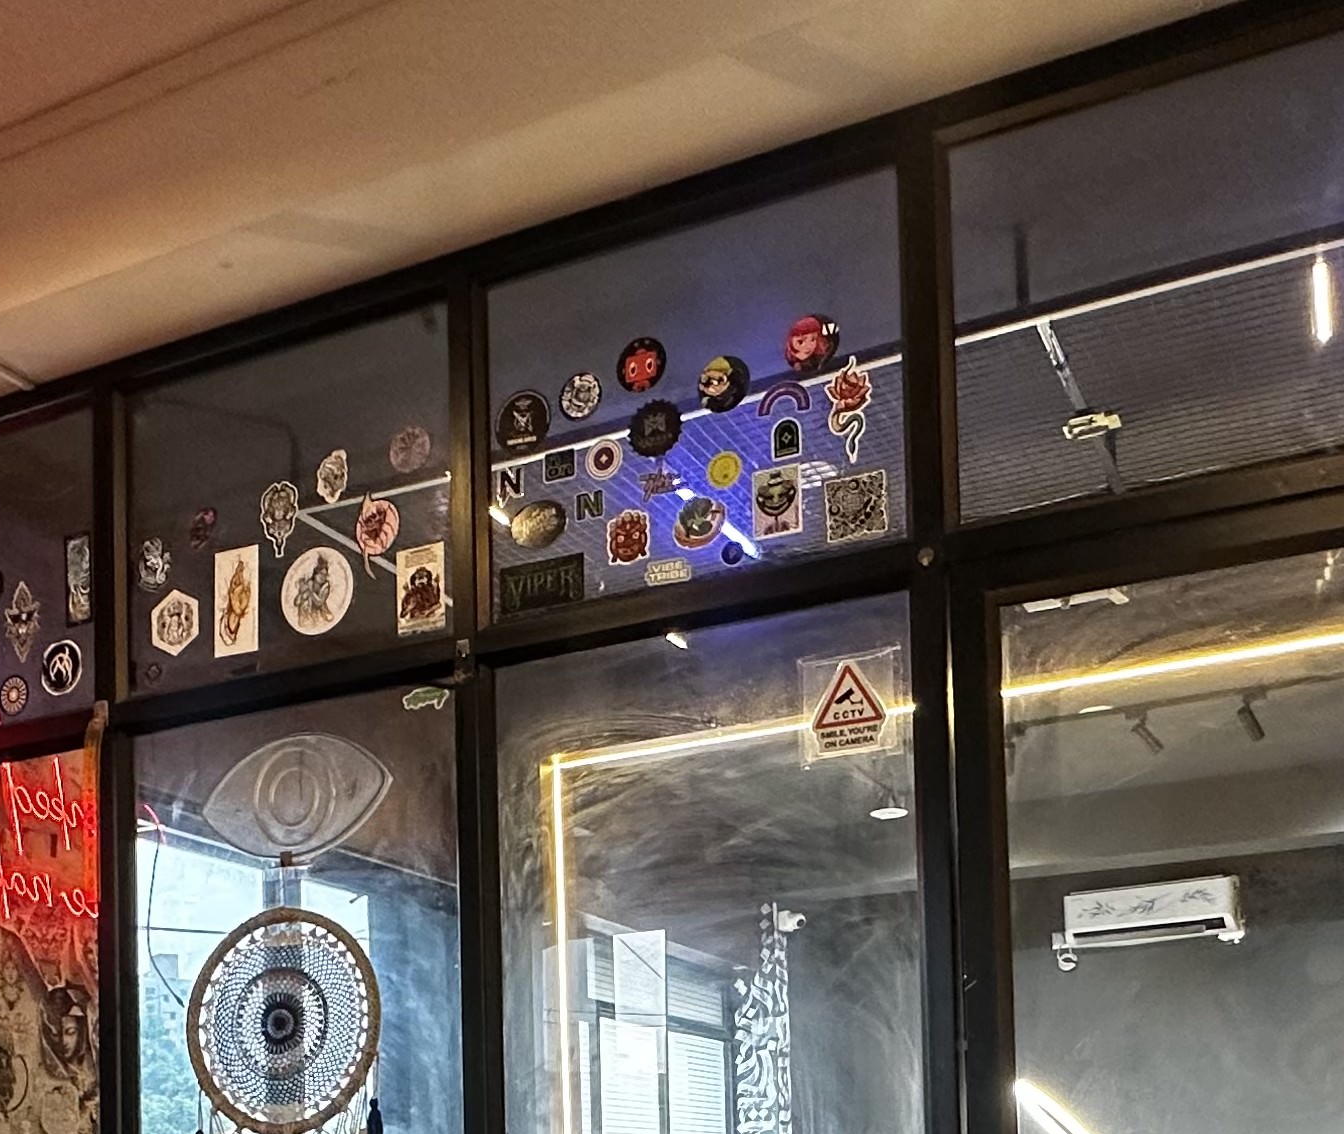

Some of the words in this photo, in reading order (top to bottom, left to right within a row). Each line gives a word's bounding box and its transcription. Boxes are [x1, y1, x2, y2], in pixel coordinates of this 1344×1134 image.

[504, 562, 582, 611] VIPER
[833, 708, 864, 720] CCTV
[824, 740, 837, 748] ON
